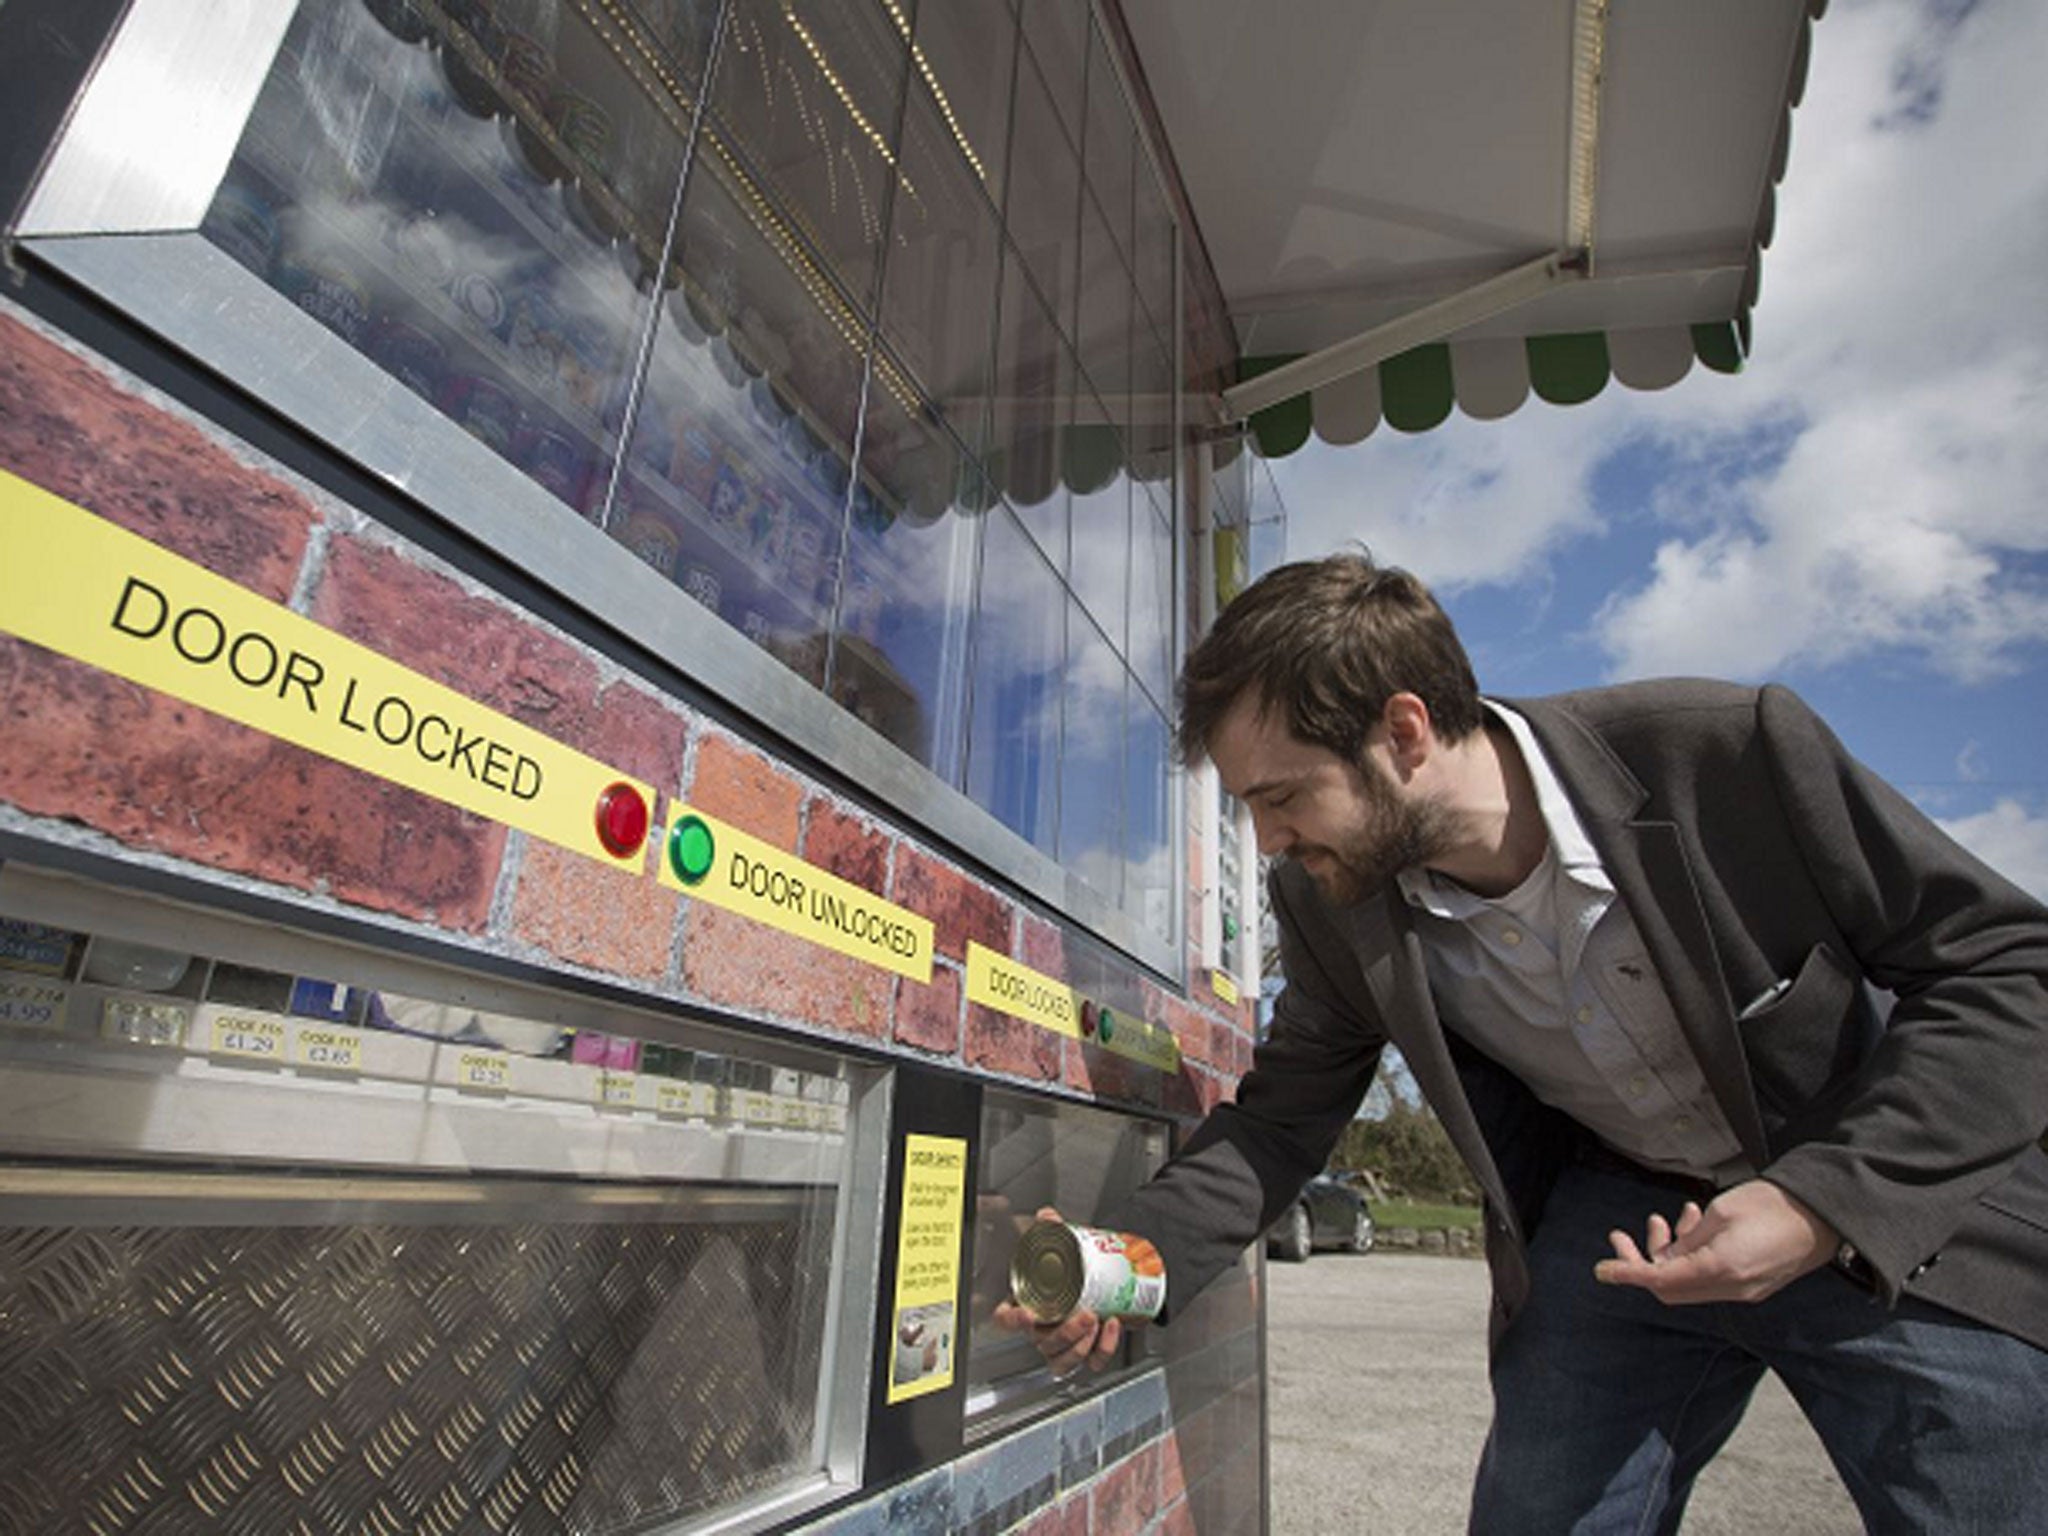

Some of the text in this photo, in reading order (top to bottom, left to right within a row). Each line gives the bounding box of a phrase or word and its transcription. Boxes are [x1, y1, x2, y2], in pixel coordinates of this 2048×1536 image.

[110, 575, 542, 801] DOOR LOCKED
[730, 852, 917, 958] DOOR UNLOCKED
[989, 967, 1071, 1022] DOOR LOCKED
[215, 1016, 255, 1032] CODE
[300, 1030, 334, 1046] CODE
[224, 1033, 275, 1054] £1.29
